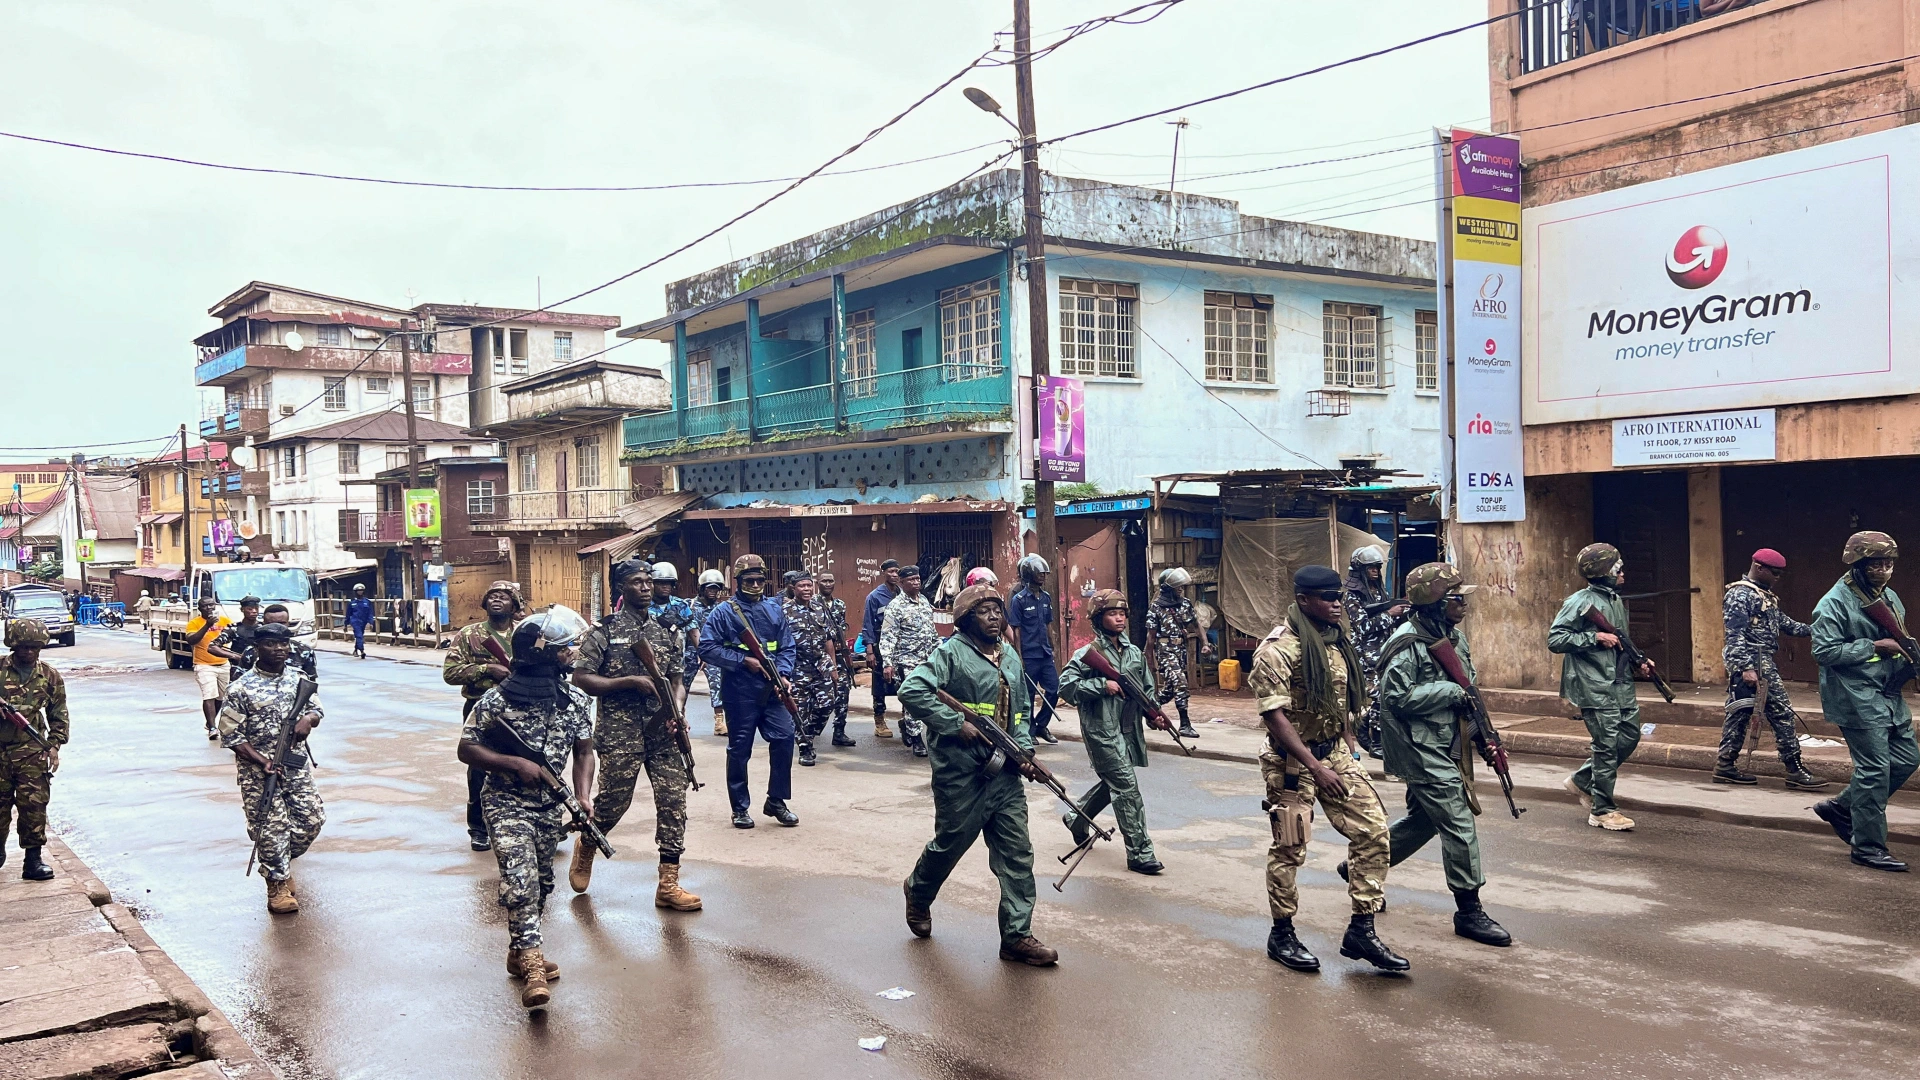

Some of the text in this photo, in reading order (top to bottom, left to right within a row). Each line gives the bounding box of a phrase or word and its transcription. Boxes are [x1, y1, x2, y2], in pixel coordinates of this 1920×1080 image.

[1471, 165, 1514, 180] Available Here
[1458, 218, 1495, 229] WESTERN
[1470, 227, 1495, 236] UNION
[1473, 299, 1507, 314] AFRO
[1472, 311, 1508, 320] INTERNATIONAL
[1587, 288, 1812, 339] MoneyGram
[1615, 328, 1776, 361] money transfer
[1468, 356, 1511, 369] MoneyGram
[1468, 412, 1493, 435] ria
[1494, 420, 1511, 428] Money
[1621, 416, 1762, 437] AFRO INTERNATIONAL
[1494, 428, 1513, 436] Transfer
[1643, 435, 1737, 447] 1ST FLOOR, 27 KISSY ROAD
[1650, 452, 1674, 460] BRANCH
[1674, 451, 1704, 460] LOCATION
[1705, 451, 1717, 459] NO.
[1058, 459, 1080, 468] BEYOND
[1048, 465, 1080, 474] YOUR LIMIT
[1073, 503, 1087, 513] TELE
[1091, 501, 1115, 512] CENTER
[1121, 499, 1137, 510] VCD
[1480, 496, 1503, 505] TOP-UP
[1476, 504, 1507, 513] SOLD HERE
[802, 532, 827, 557] SMS
